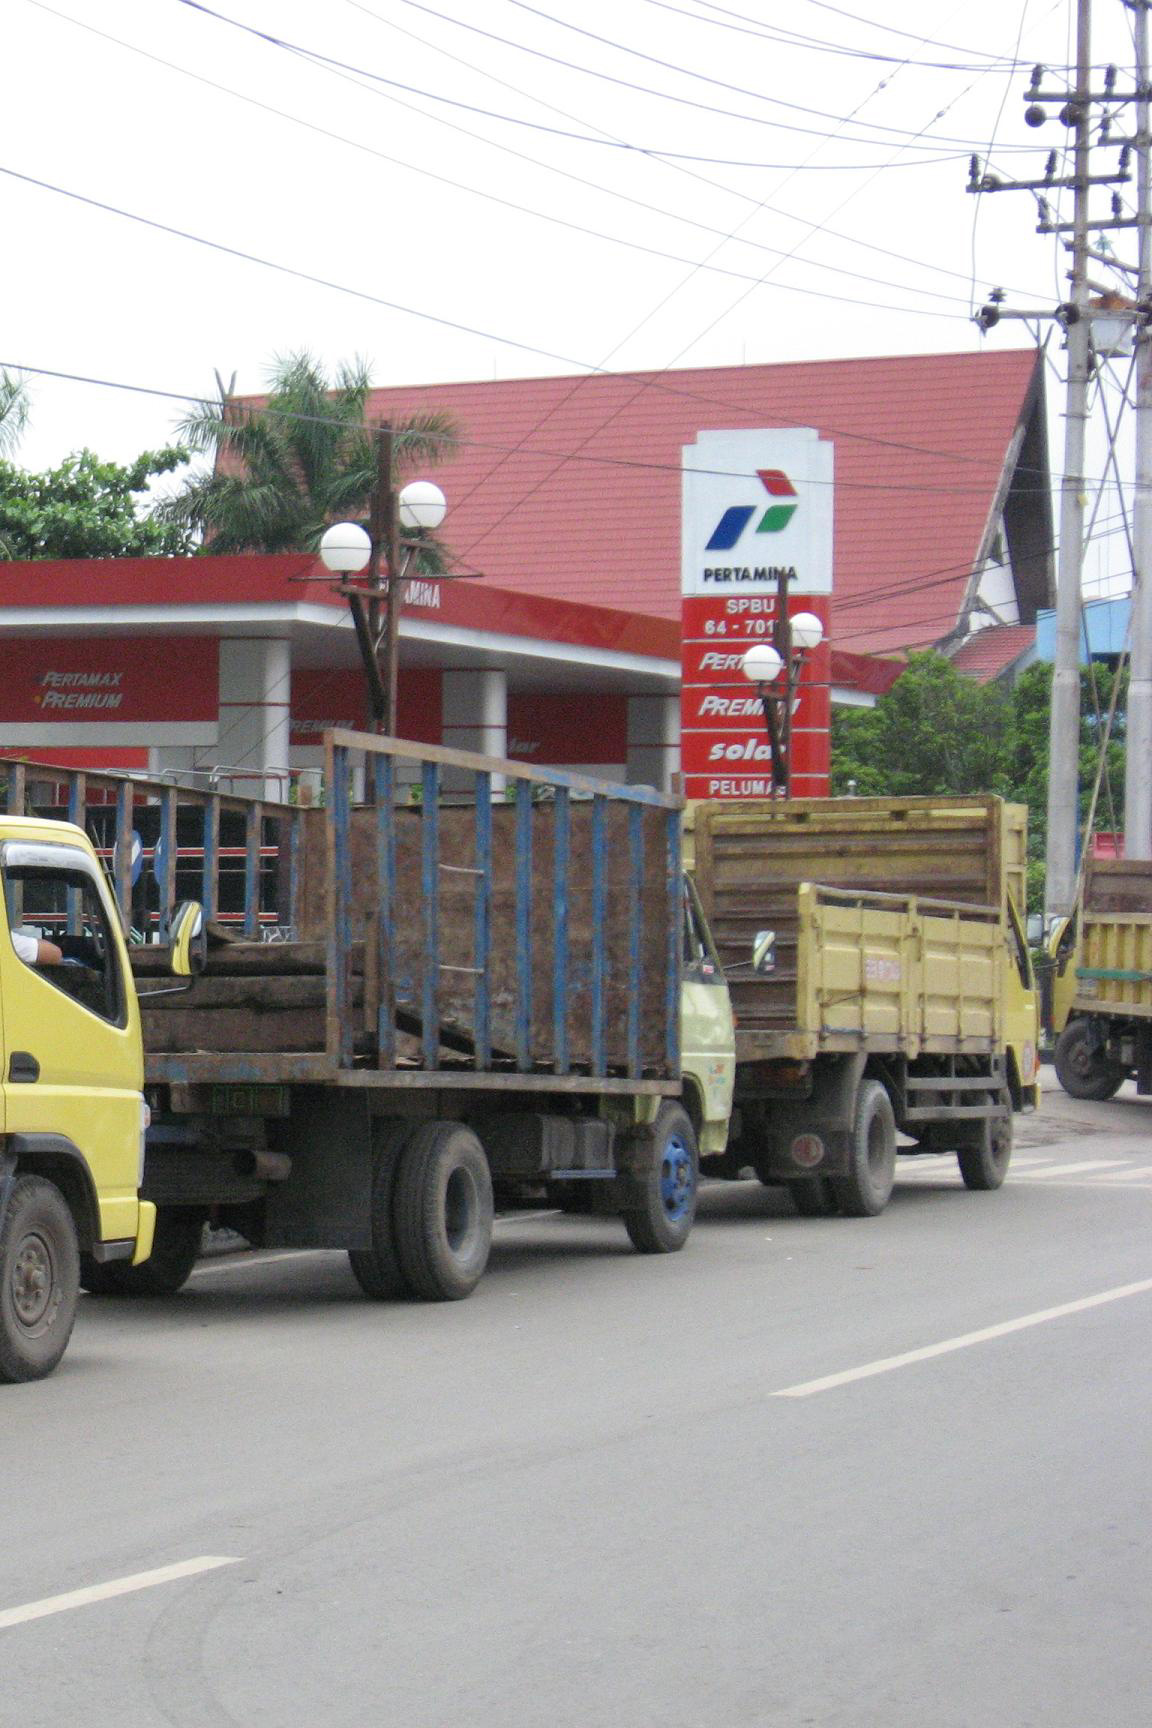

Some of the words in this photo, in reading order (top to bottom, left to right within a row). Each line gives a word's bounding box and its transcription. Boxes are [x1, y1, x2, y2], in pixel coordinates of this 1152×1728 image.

[726, 598, 775, 614] SPBU
[704, 620, 727, 635] 64
[41, 671, 124, 688] PERTAMAX
[40, 690, 123, 709] PREMIUM
